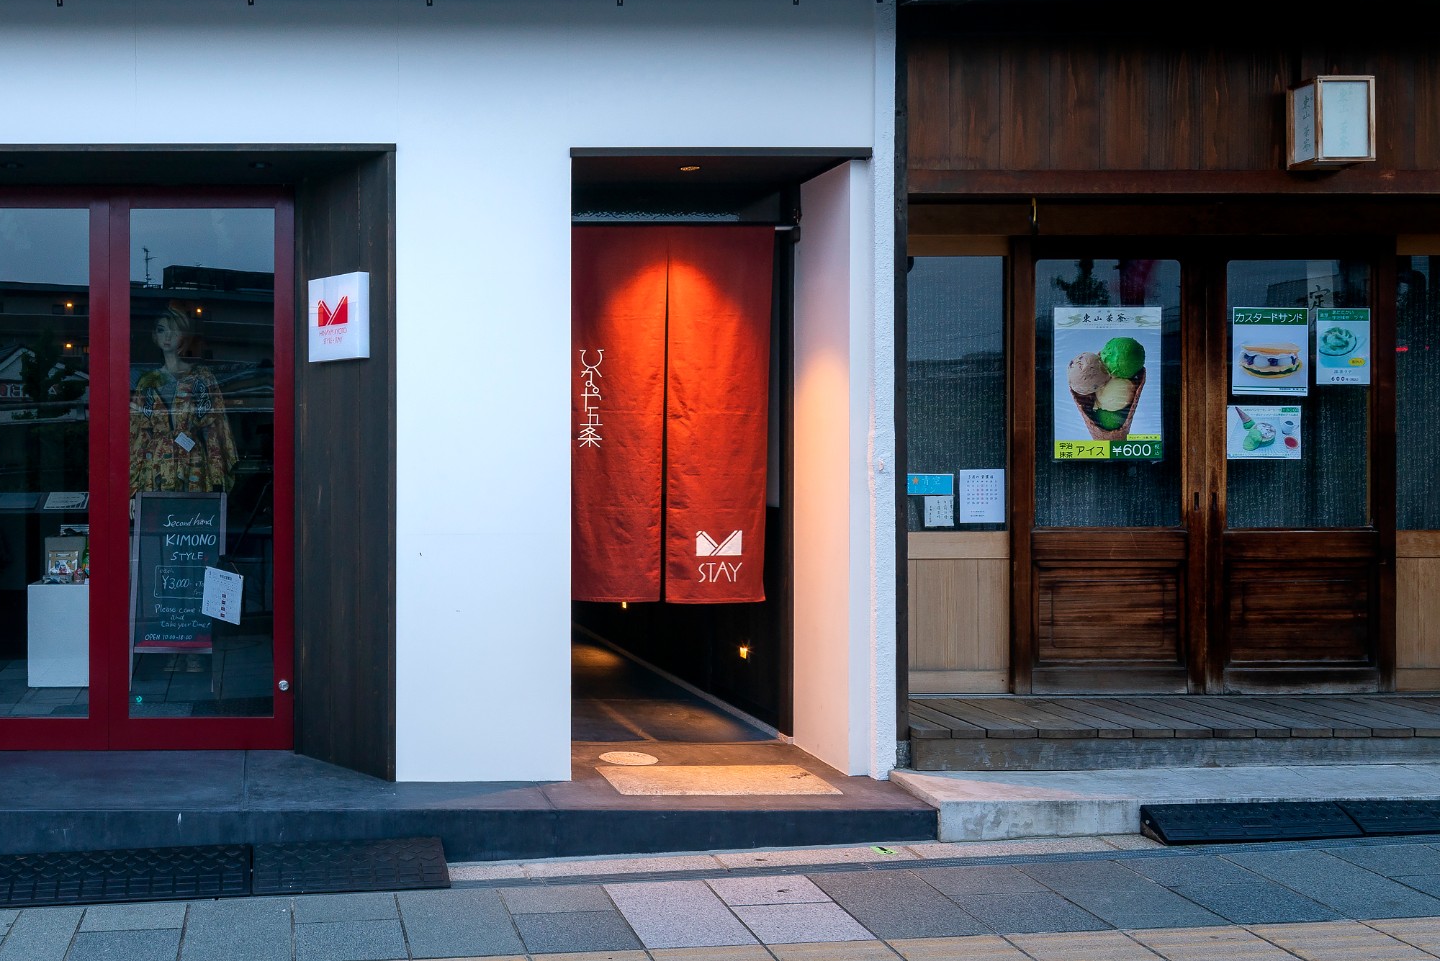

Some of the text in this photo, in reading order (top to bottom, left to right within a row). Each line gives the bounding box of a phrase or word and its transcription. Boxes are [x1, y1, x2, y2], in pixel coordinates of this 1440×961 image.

[1235, 313, 1303, 324] カスタードサンド
[1076, 446, 1105, 456] アイス
[1112, 444, 1152, 456] ¥600
[166, 533, 216, 547] KIMONO
[170, 551, 204, 561] STYLE
[698, 562, 742, 583] STAY
